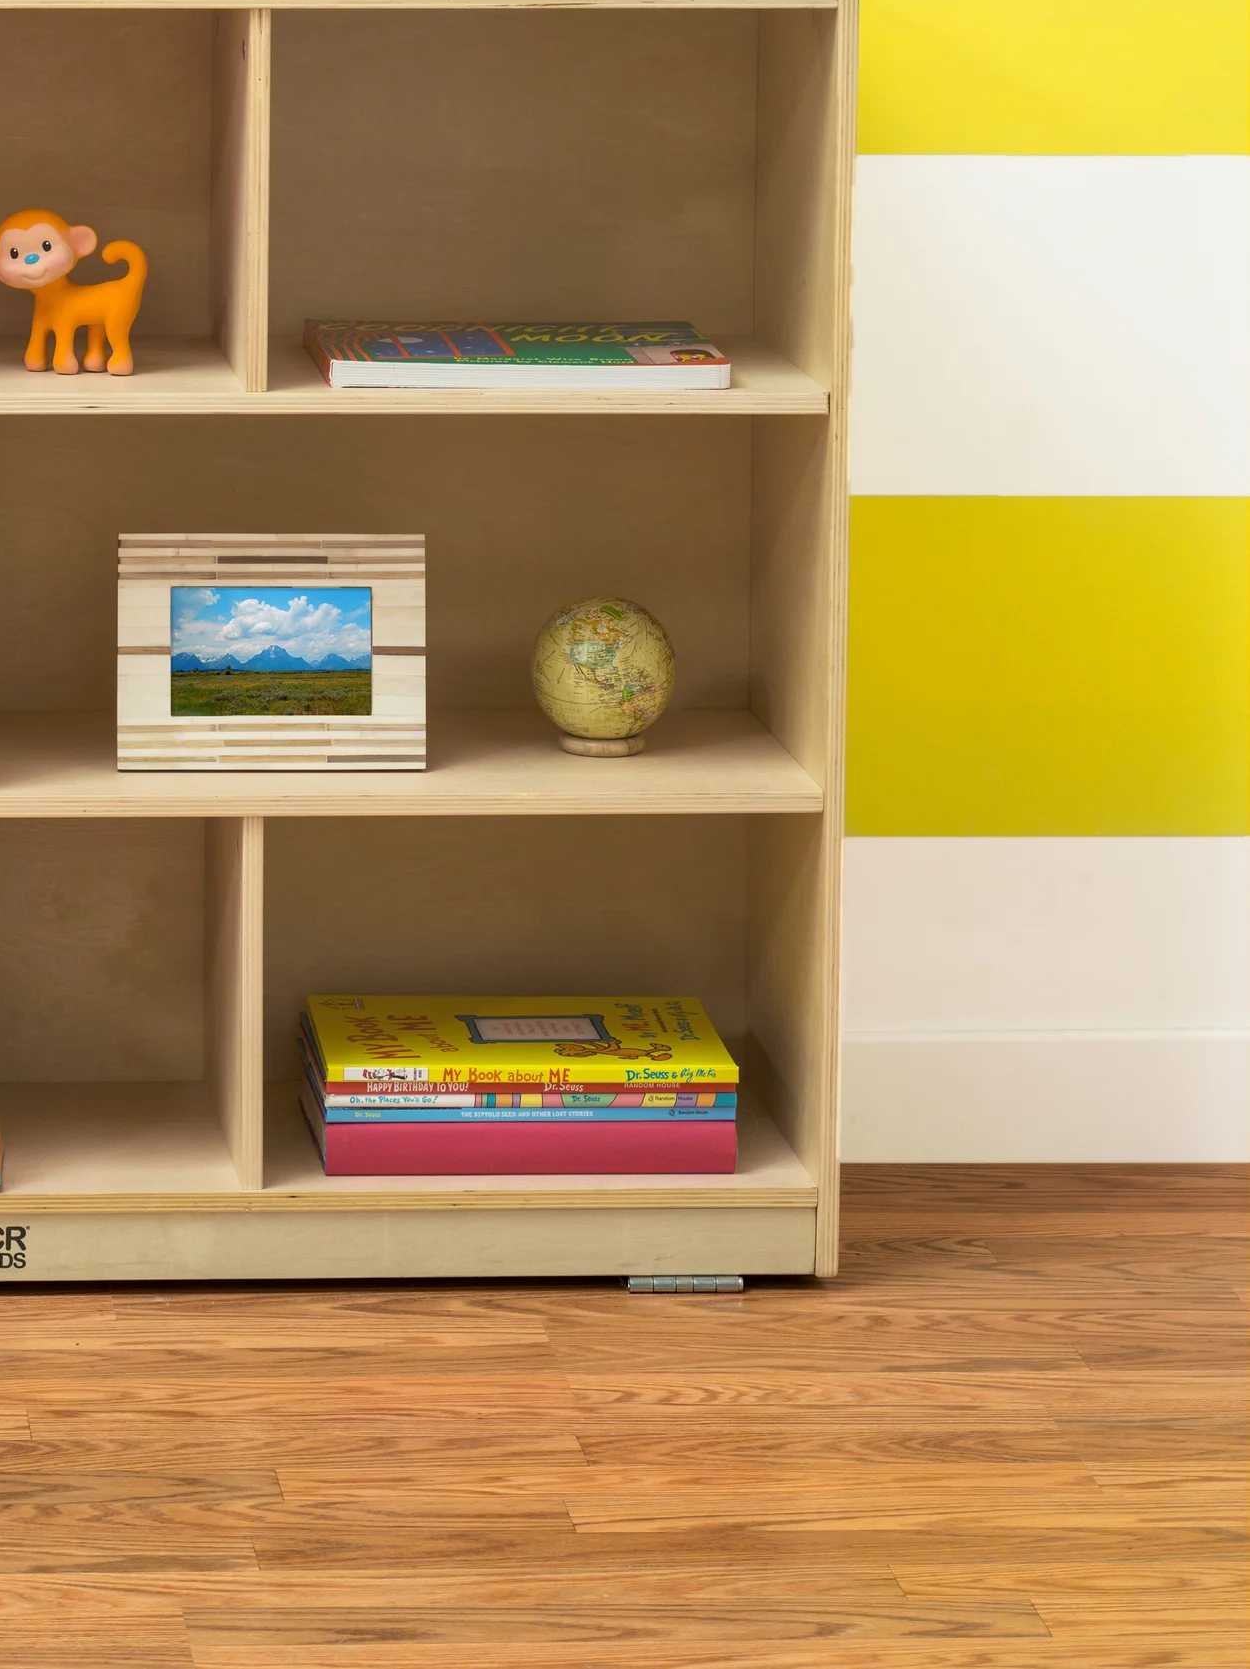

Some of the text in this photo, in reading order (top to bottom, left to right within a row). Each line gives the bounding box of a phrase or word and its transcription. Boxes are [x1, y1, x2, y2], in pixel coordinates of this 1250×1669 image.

[317, 323, 620, 333] GOODNIGHT
[510, 332, 679, 343] MOON
[386, 1015, 459, 1053] about ME
[362, 1043, 422, 1060] MY
[442, 1067, 462, 1082] MY
[507, 1069, 544, 1082] about
[548, 1068, 571, 1082] ME
[625, 1070, 642, 1081] Dr.
[643, 1068, 669, 1079] Seuss
[366, 1082, 391, 1092] HAPPY
[393, 1082, 434, 1092] BIRTHDAY
[448, 1082, 470, 1092] YOU!
[544, 1082, 584, 1092] Dr. Seuss
[378, 1096, 400, 1104] Places
[422, 1095, 439, 1104] Go!
[571, 1095, 601, 1103] Dr. Seuss
